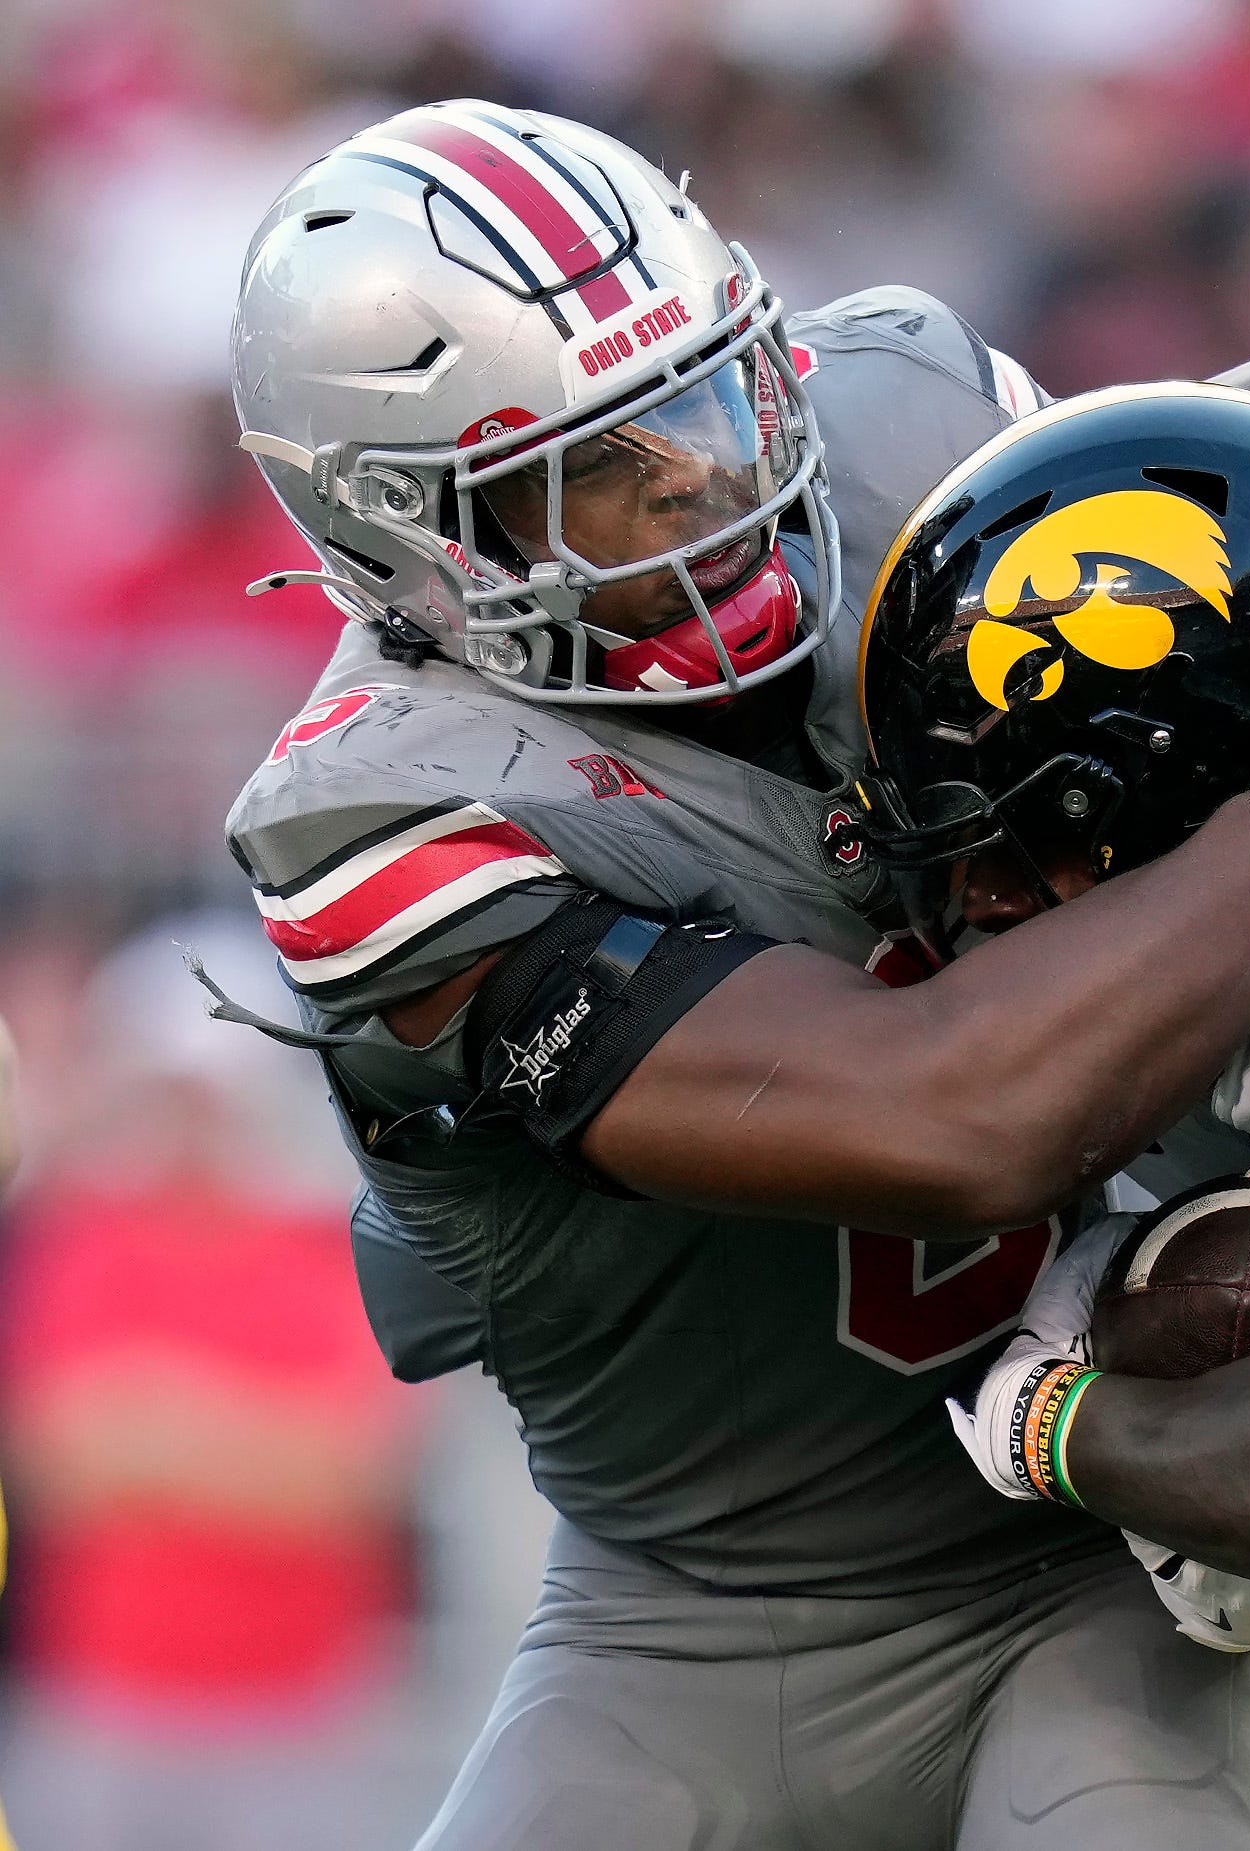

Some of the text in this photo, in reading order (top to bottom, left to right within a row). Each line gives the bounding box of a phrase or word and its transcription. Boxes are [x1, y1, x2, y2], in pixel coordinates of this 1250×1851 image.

[578, 296, 691, 376] OHIO STATE
[519, 998, 591, 1080] Douglas
[1024, 1365, 1047, 1390] BE
[1010, 1394, 1030, 1454] YOUR
[1025, 1364, 1076, 1480] ASTER OF MY
[1038, 1388, 1066, 1484] FOOTBALL
